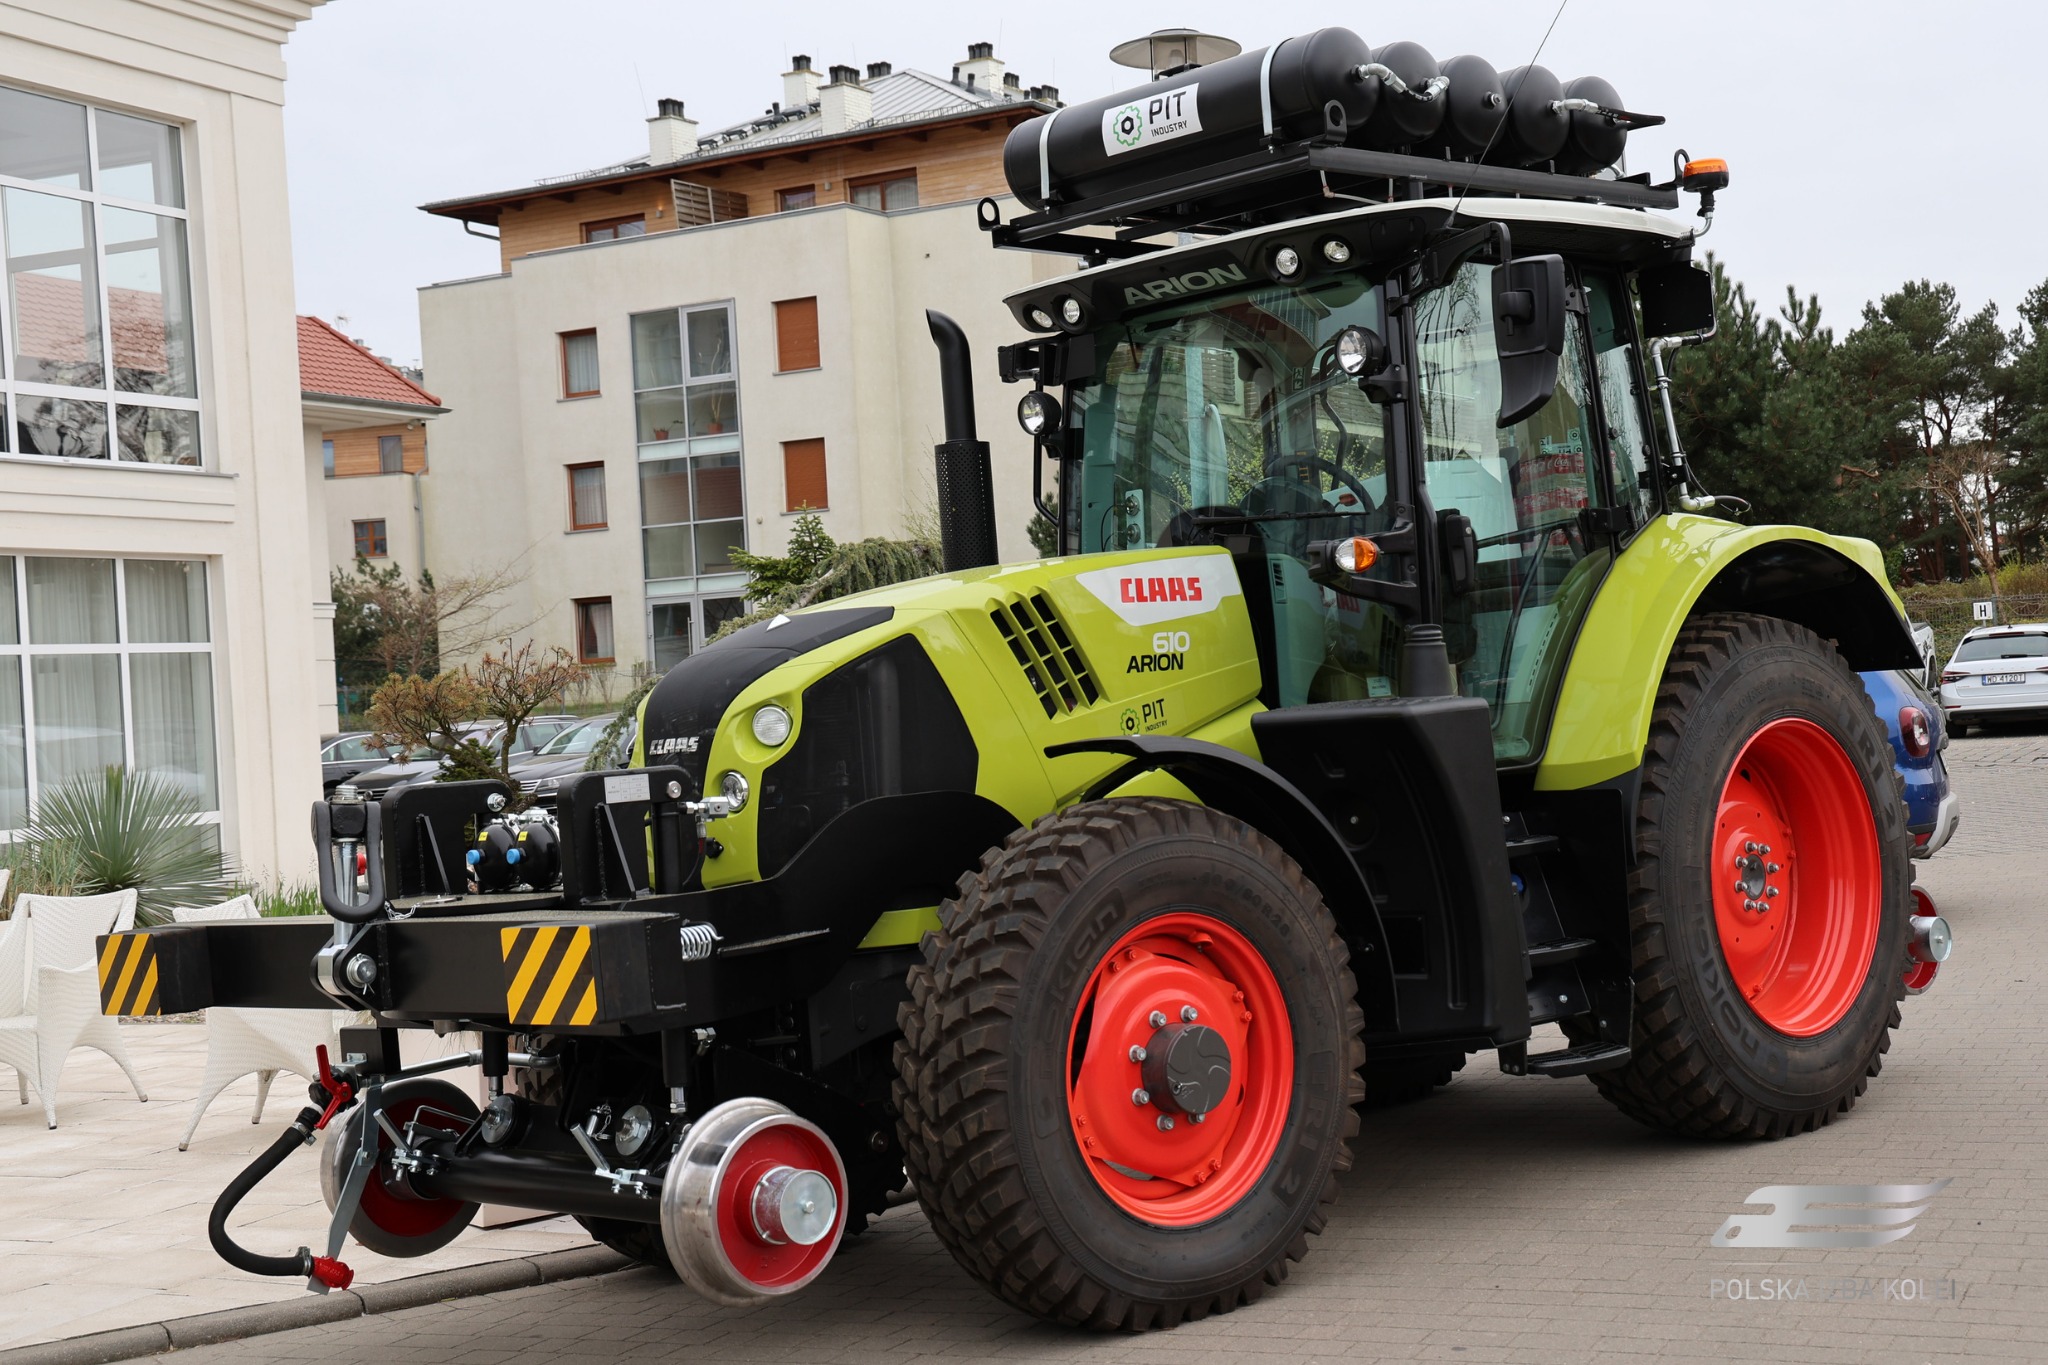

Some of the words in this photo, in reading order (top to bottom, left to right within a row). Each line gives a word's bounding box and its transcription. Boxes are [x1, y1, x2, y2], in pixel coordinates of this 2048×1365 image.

[1149, 91, 1187, 125] PIT
[1150, 120, 1188, 137] INDUSTRY
[1123, 263, 1247, 305] ARION
[1119, 577, 1203, 603] CLAAS
[1979, 604, 1987, 617] H
[1153, 631, 1191, 653] 610
[1126, 653, 1184, 674] ARION
[1141, 698, 1165, 723] PIT
[1145, 720, 1168, 732] INDUSTRY
[649, 736, 700, 756] CLAAS
